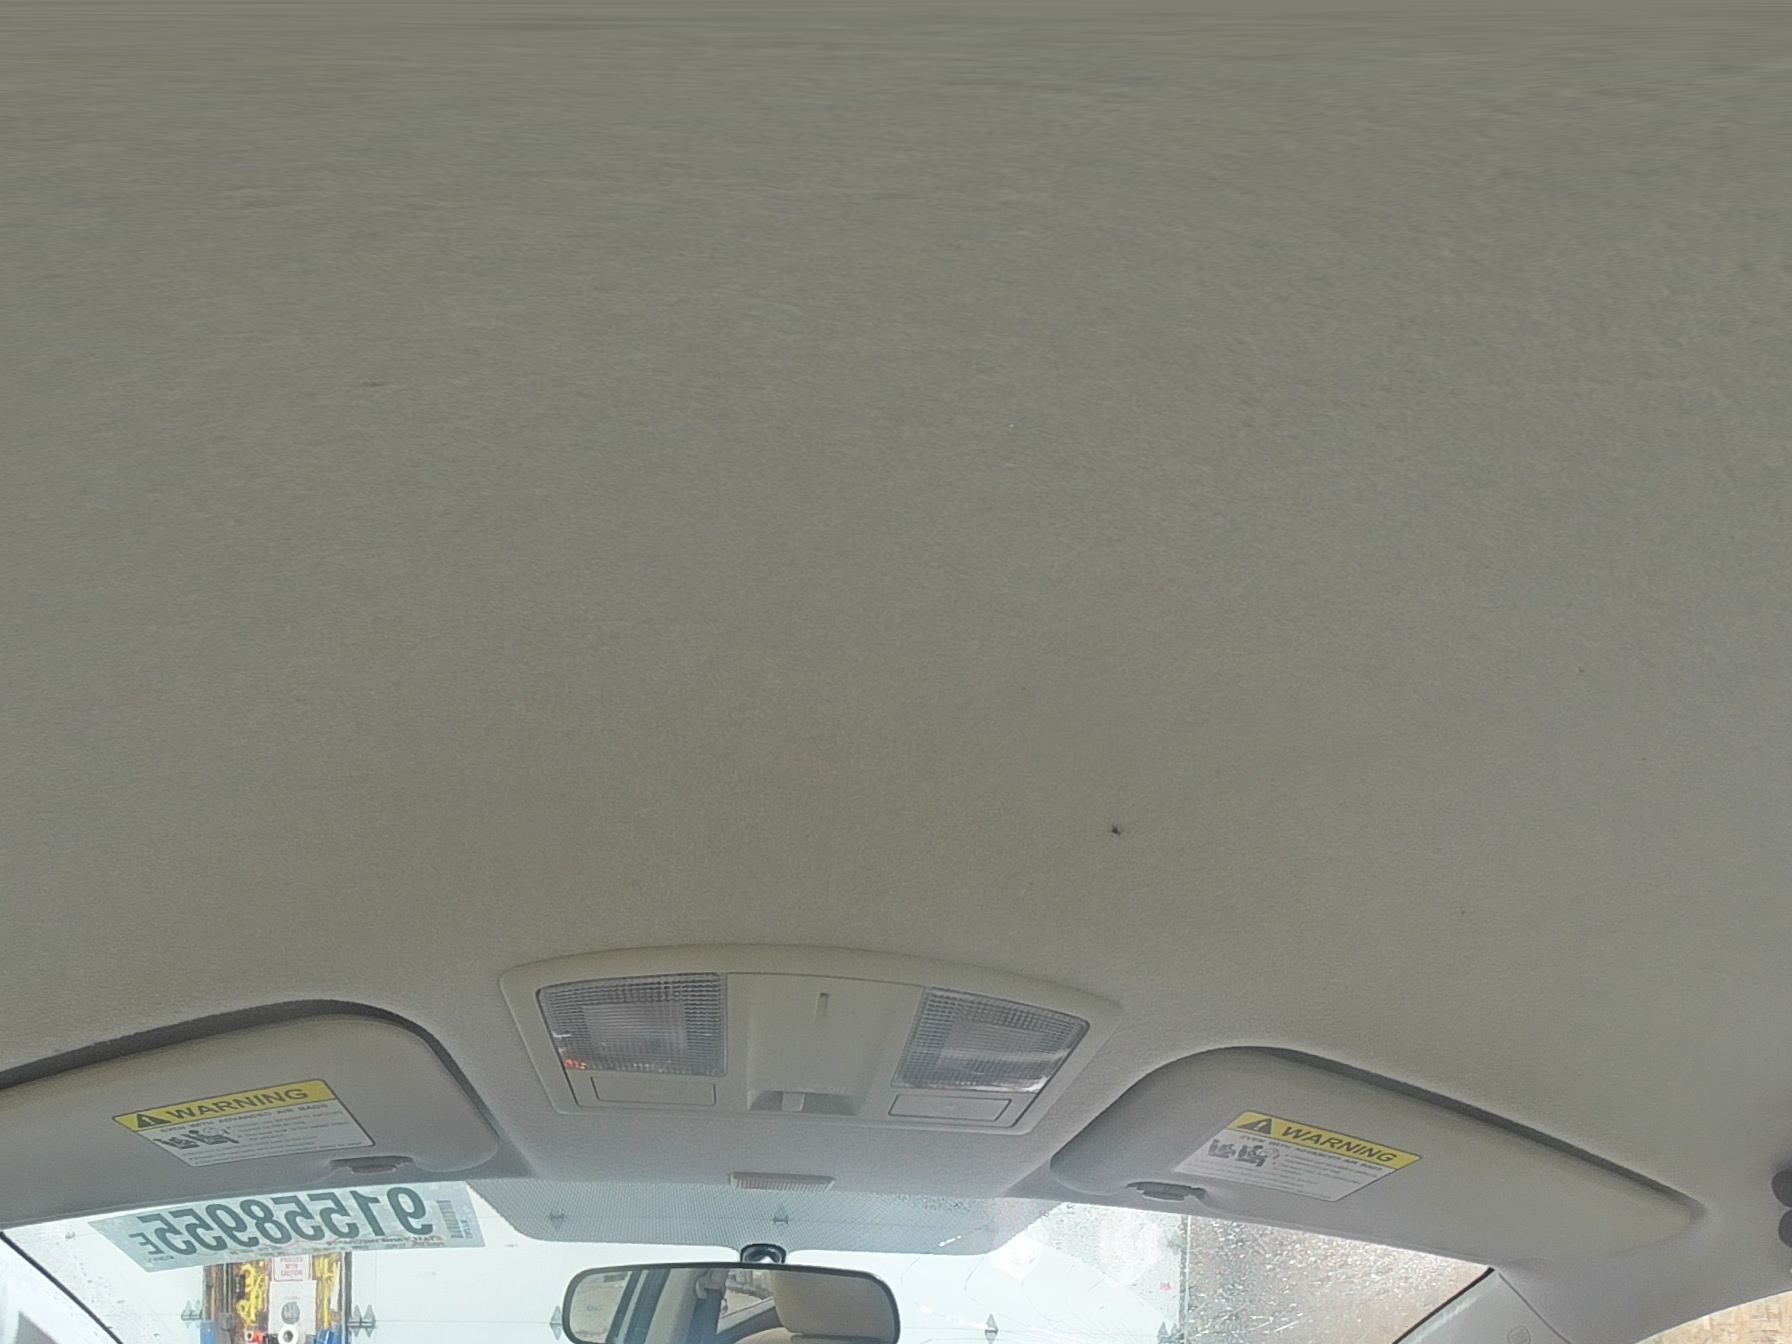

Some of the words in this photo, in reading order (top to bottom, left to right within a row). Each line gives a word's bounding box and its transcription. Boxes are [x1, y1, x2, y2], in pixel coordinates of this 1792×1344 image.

[166, 1087, 310, 1121] WARNING
[218, 1112, 273, 1124] ADVANCED
[1281, 1126, 1398, 1163] WARNING
